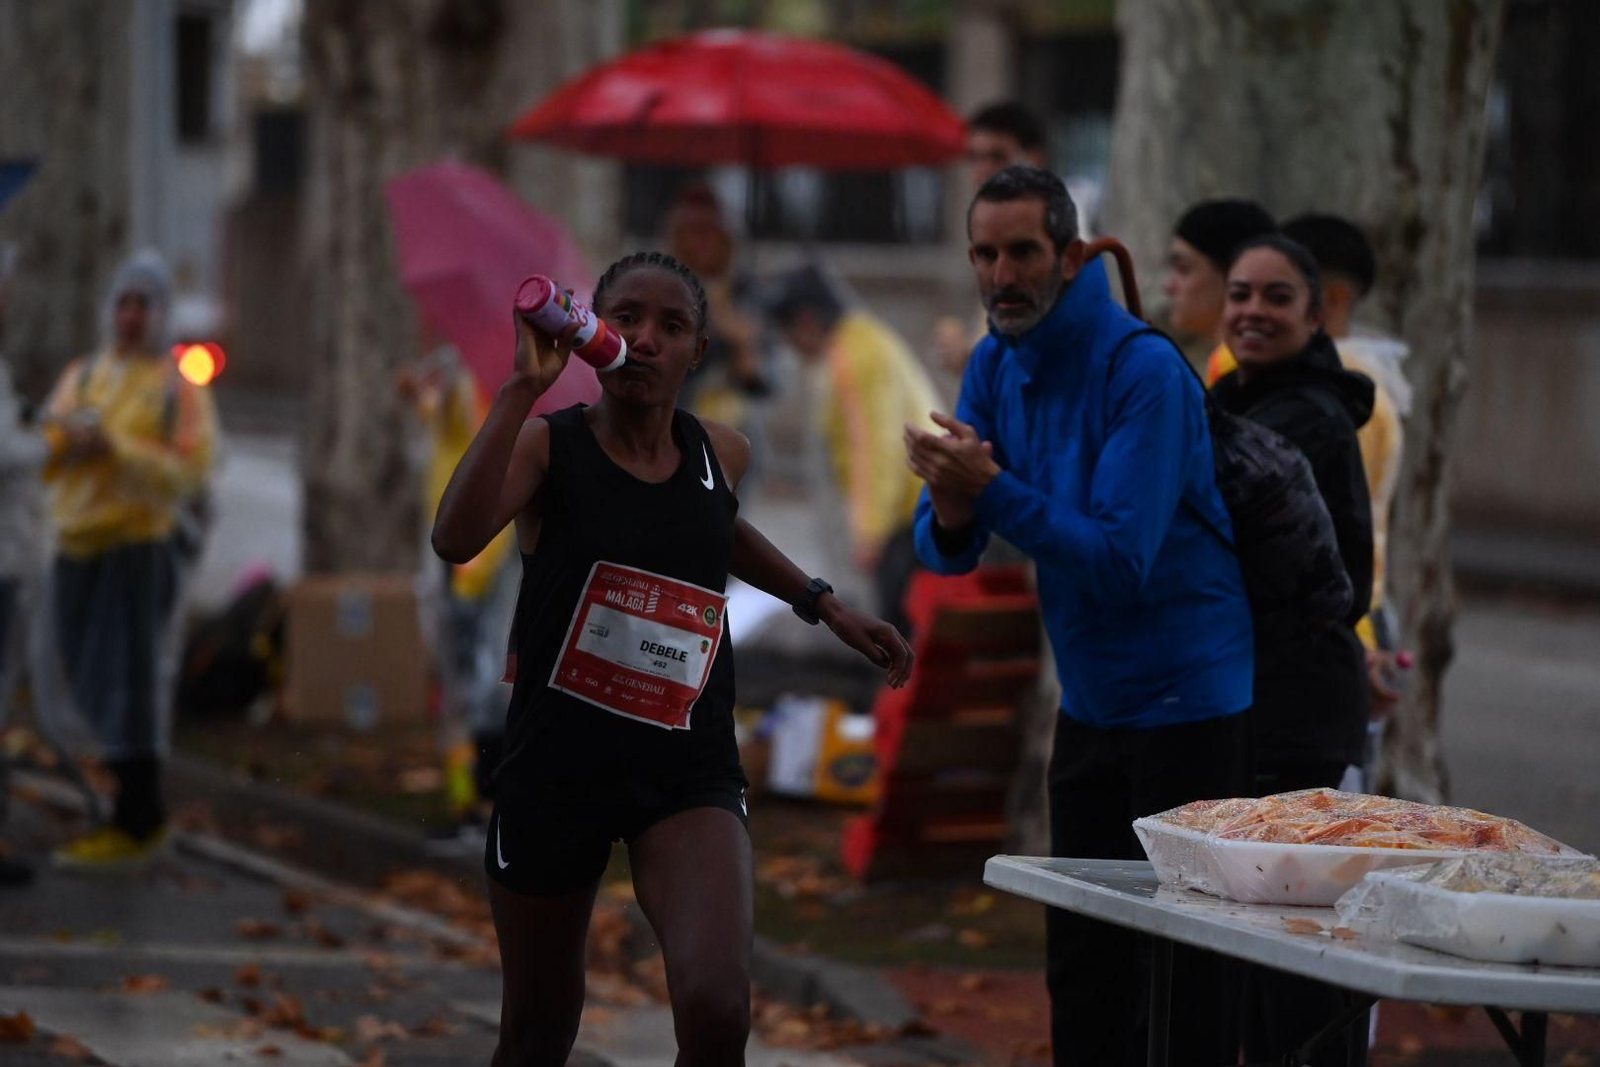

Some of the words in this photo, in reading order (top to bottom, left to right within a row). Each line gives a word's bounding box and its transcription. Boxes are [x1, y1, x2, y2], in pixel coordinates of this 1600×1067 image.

[678, 603, 698, 616] 42K
[640, 640, 688, 663] DEBELE
[625, 678, 665, 695] GENERALI
